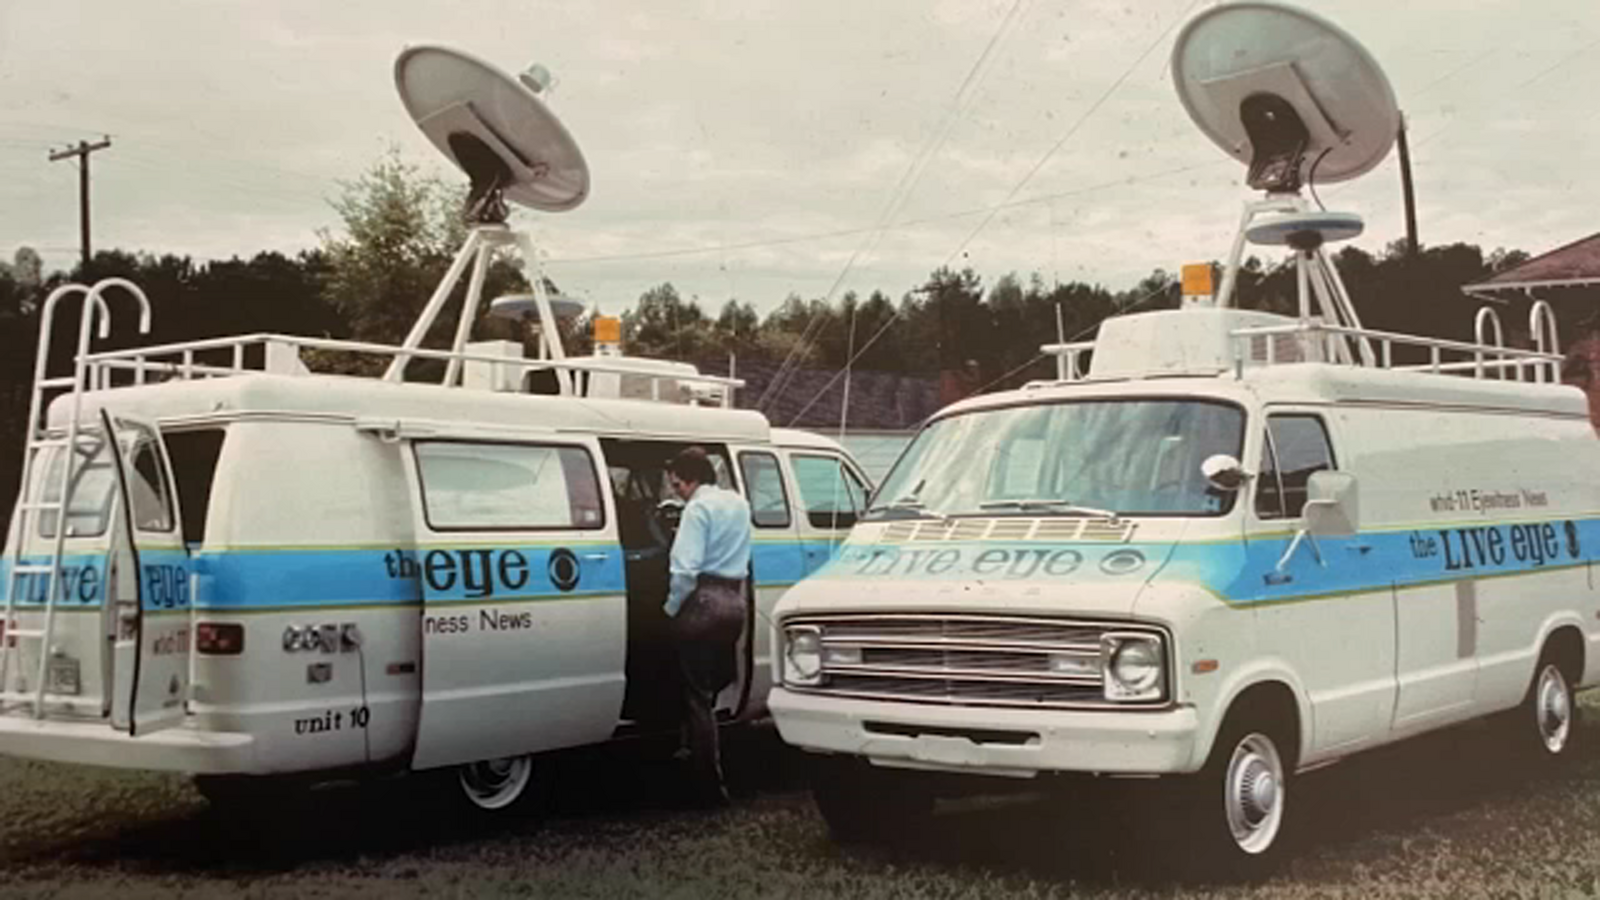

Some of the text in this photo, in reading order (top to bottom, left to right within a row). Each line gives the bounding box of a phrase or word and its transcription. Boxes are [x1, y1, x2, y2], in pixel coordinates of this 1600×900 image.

[1410, 530, 1437, 559] the
[1510, 523, 1558, 566] eye
[385, 548, 529, 598] th eye
[972, 549, 1084, 579] eye
[145, 564, 189, 608] eye
[480, 609, 532, 631] News
[295, 706, 370, 735] unit 10
